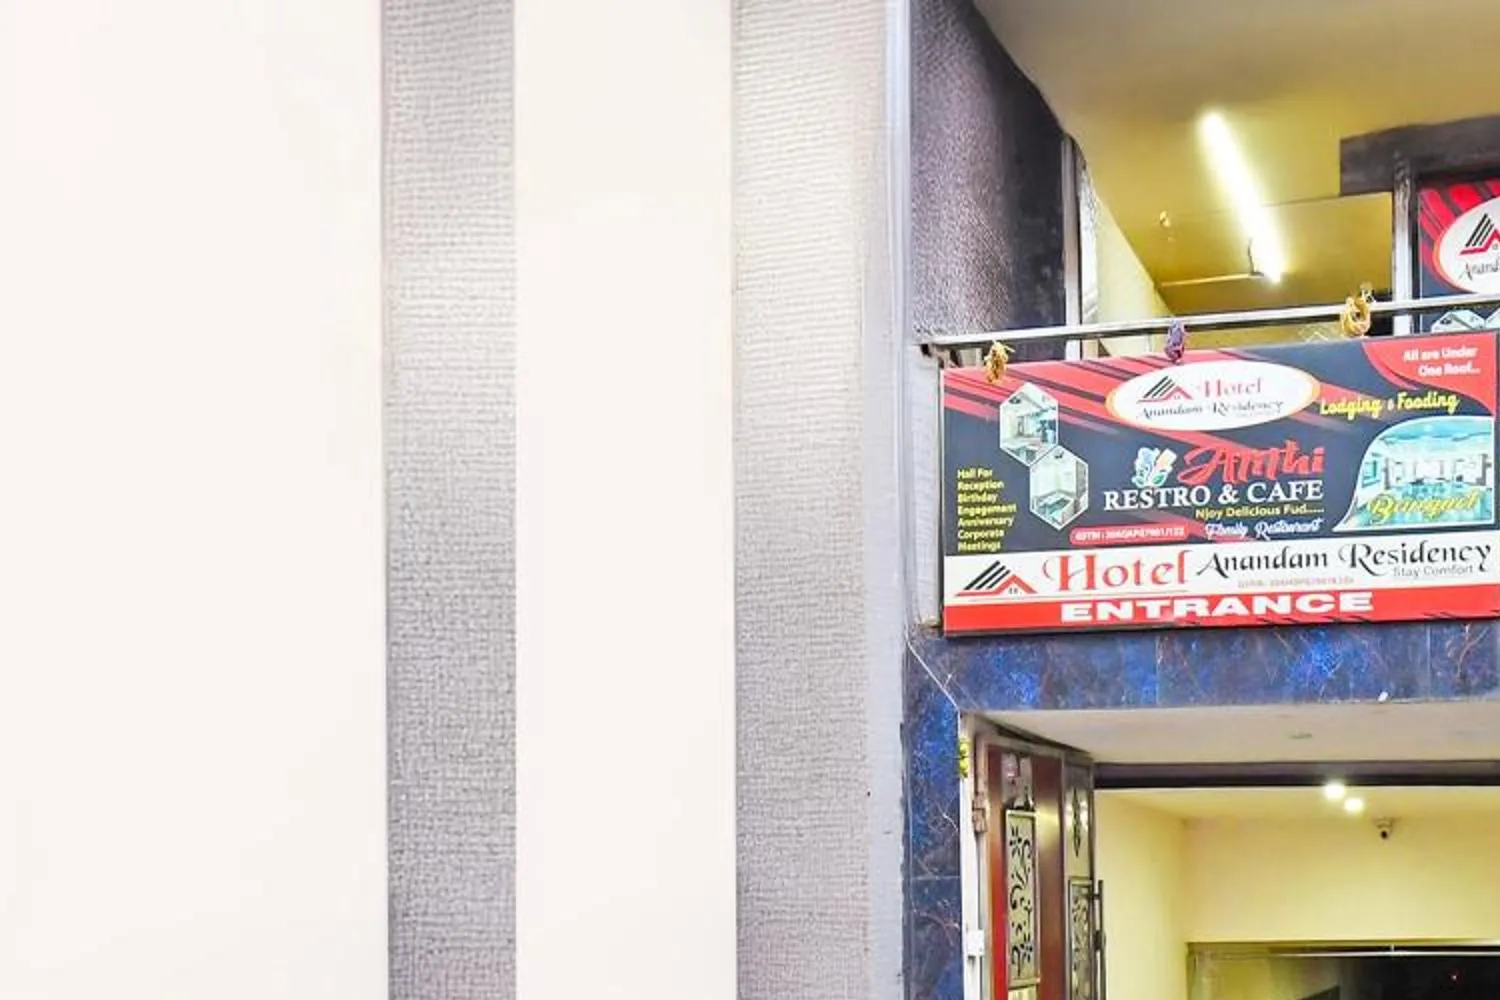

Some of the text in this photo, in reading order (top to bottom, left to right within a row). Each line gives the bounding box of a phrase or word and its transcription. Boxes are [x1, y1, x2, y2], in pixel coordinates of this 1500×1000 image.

[1442, 346, 1478, 357] Under
[1198, 377, 1262, 398] Hotel
[1136, 403, 1203, 421] Anandam
[1207, 400, 1284, 417] Residency
[1320, 397, 1383, 421] Lodging
[1397, 391, 1461, 413] Fooding
[977, 468, 993, 478] For
[957, 481, 1005, 492] Reception
[957, 491, 998, 504] Birthday
[1103, 479, 1325, 511] RESTRO & CAFE
[957, 503, 1017, 516] Engagement
[1225, 508, 1281, 518] Delicious
[957, 516, 1015, 528] Anniversary
[957, 529, 1005, 541] Corporate
[957, 541, 1002, 553] Meetings
[1042, 540, 1491, 591] Hotel Anandam Residency
[1060, 592, 1375, 623] ENTRANCE
